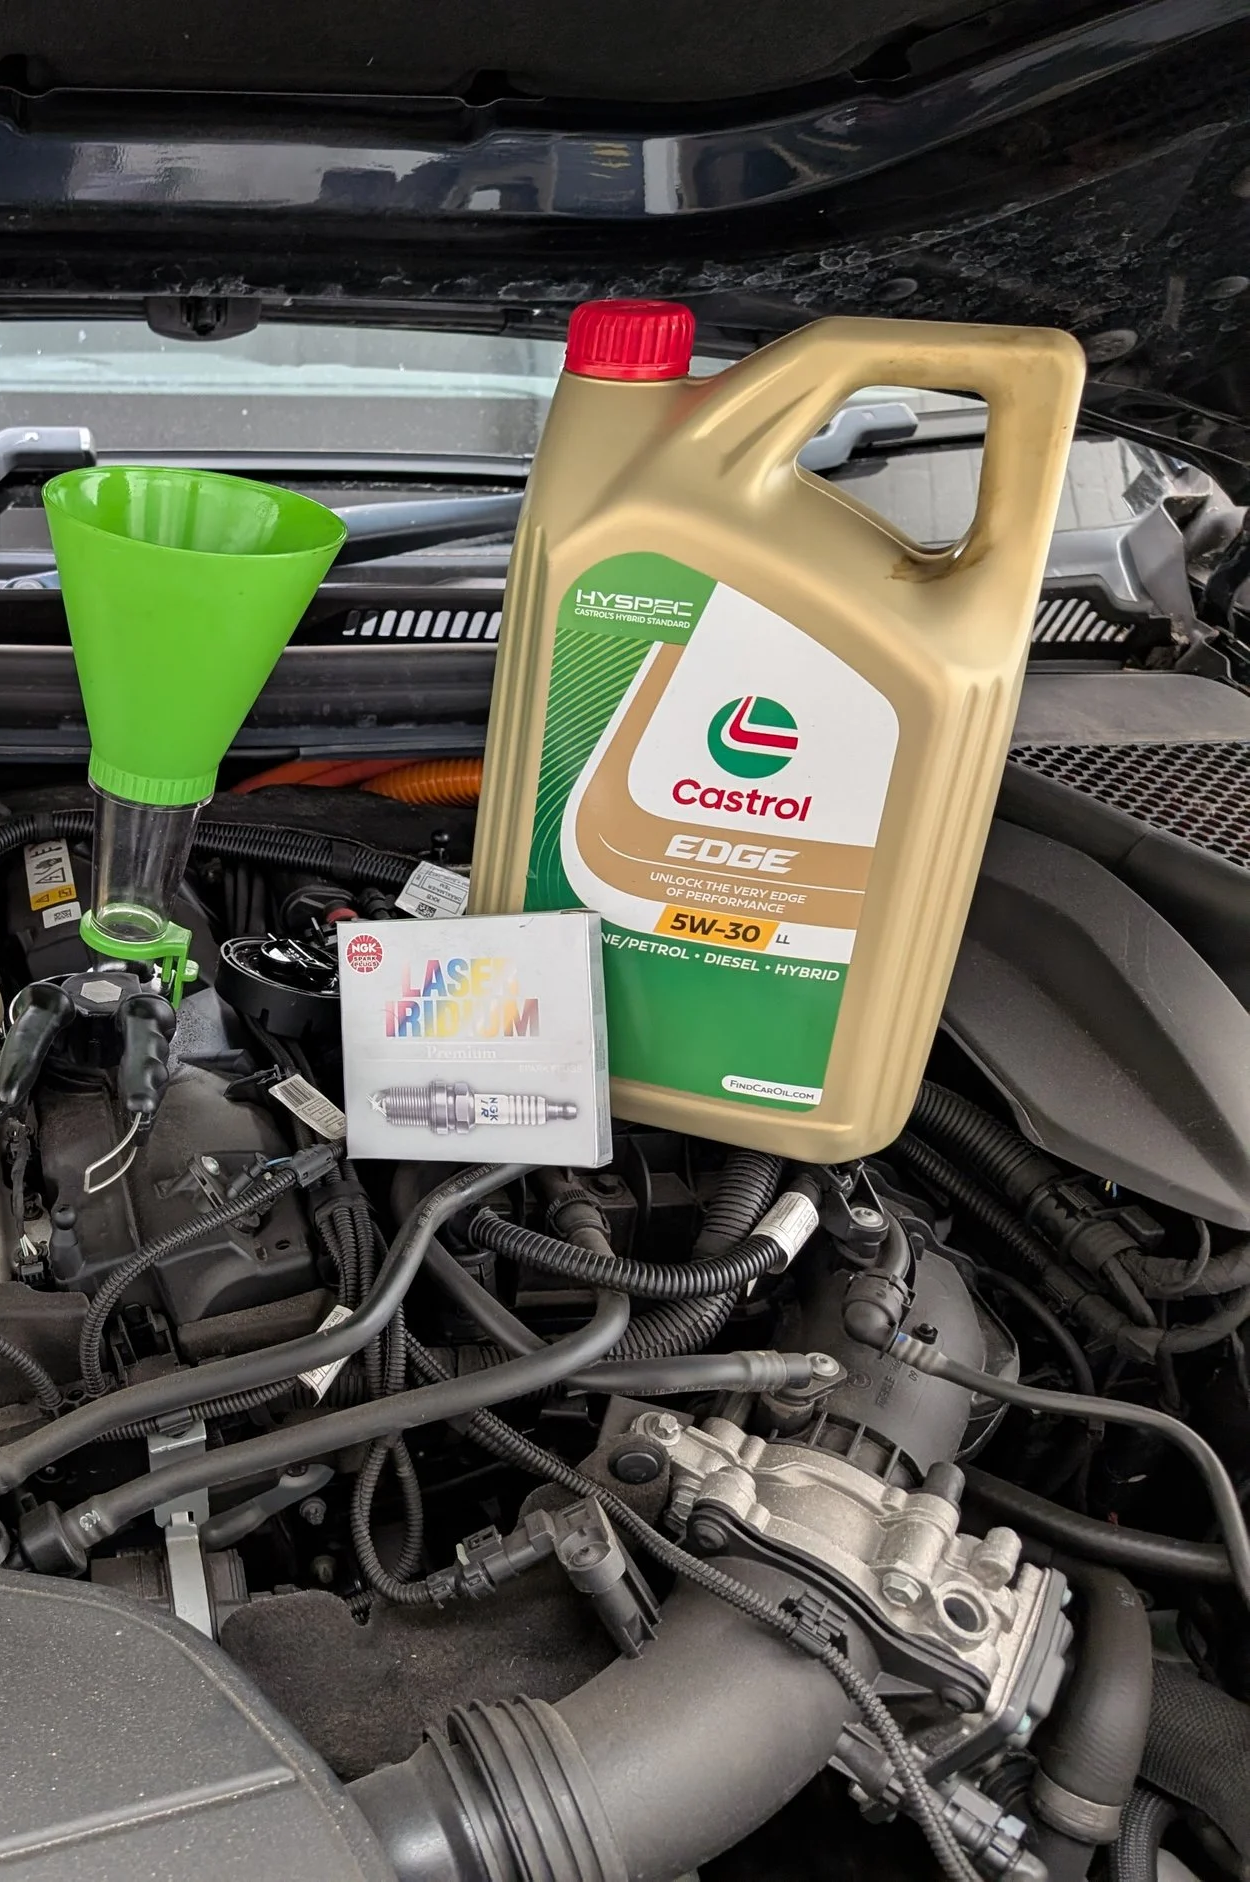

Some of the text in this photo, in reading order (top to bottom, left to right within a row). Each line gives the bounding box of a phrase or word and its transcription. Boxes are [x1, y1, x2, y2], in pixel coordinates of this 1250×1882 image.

[574, 607, 691, 629] CASTROL'S HYBRID STANDARD
[575, 589, 694, 617] HYSPEC
[671, 778, 812, 822] Castrol
[664, 834, 801, 874] EDGE
[649, 871, 808, 905] UNLOCK THE VERY EDGE
[666, 887, 786, 914] OF PERFORMANCE
[670, 912, 791, 945] 5W-30 LL
[351, 943, 377, 953] NGK
[402, 958, 519, 997] LASER
[703, 951, 761, 972] DIESEL
[774, 963, 841, 982] HYBRID
[385, 998, 540, 1038] IRIDIUM
[425, 1045, 497, 1059] Premium
[489, 1097, 499, 1122] NGK
